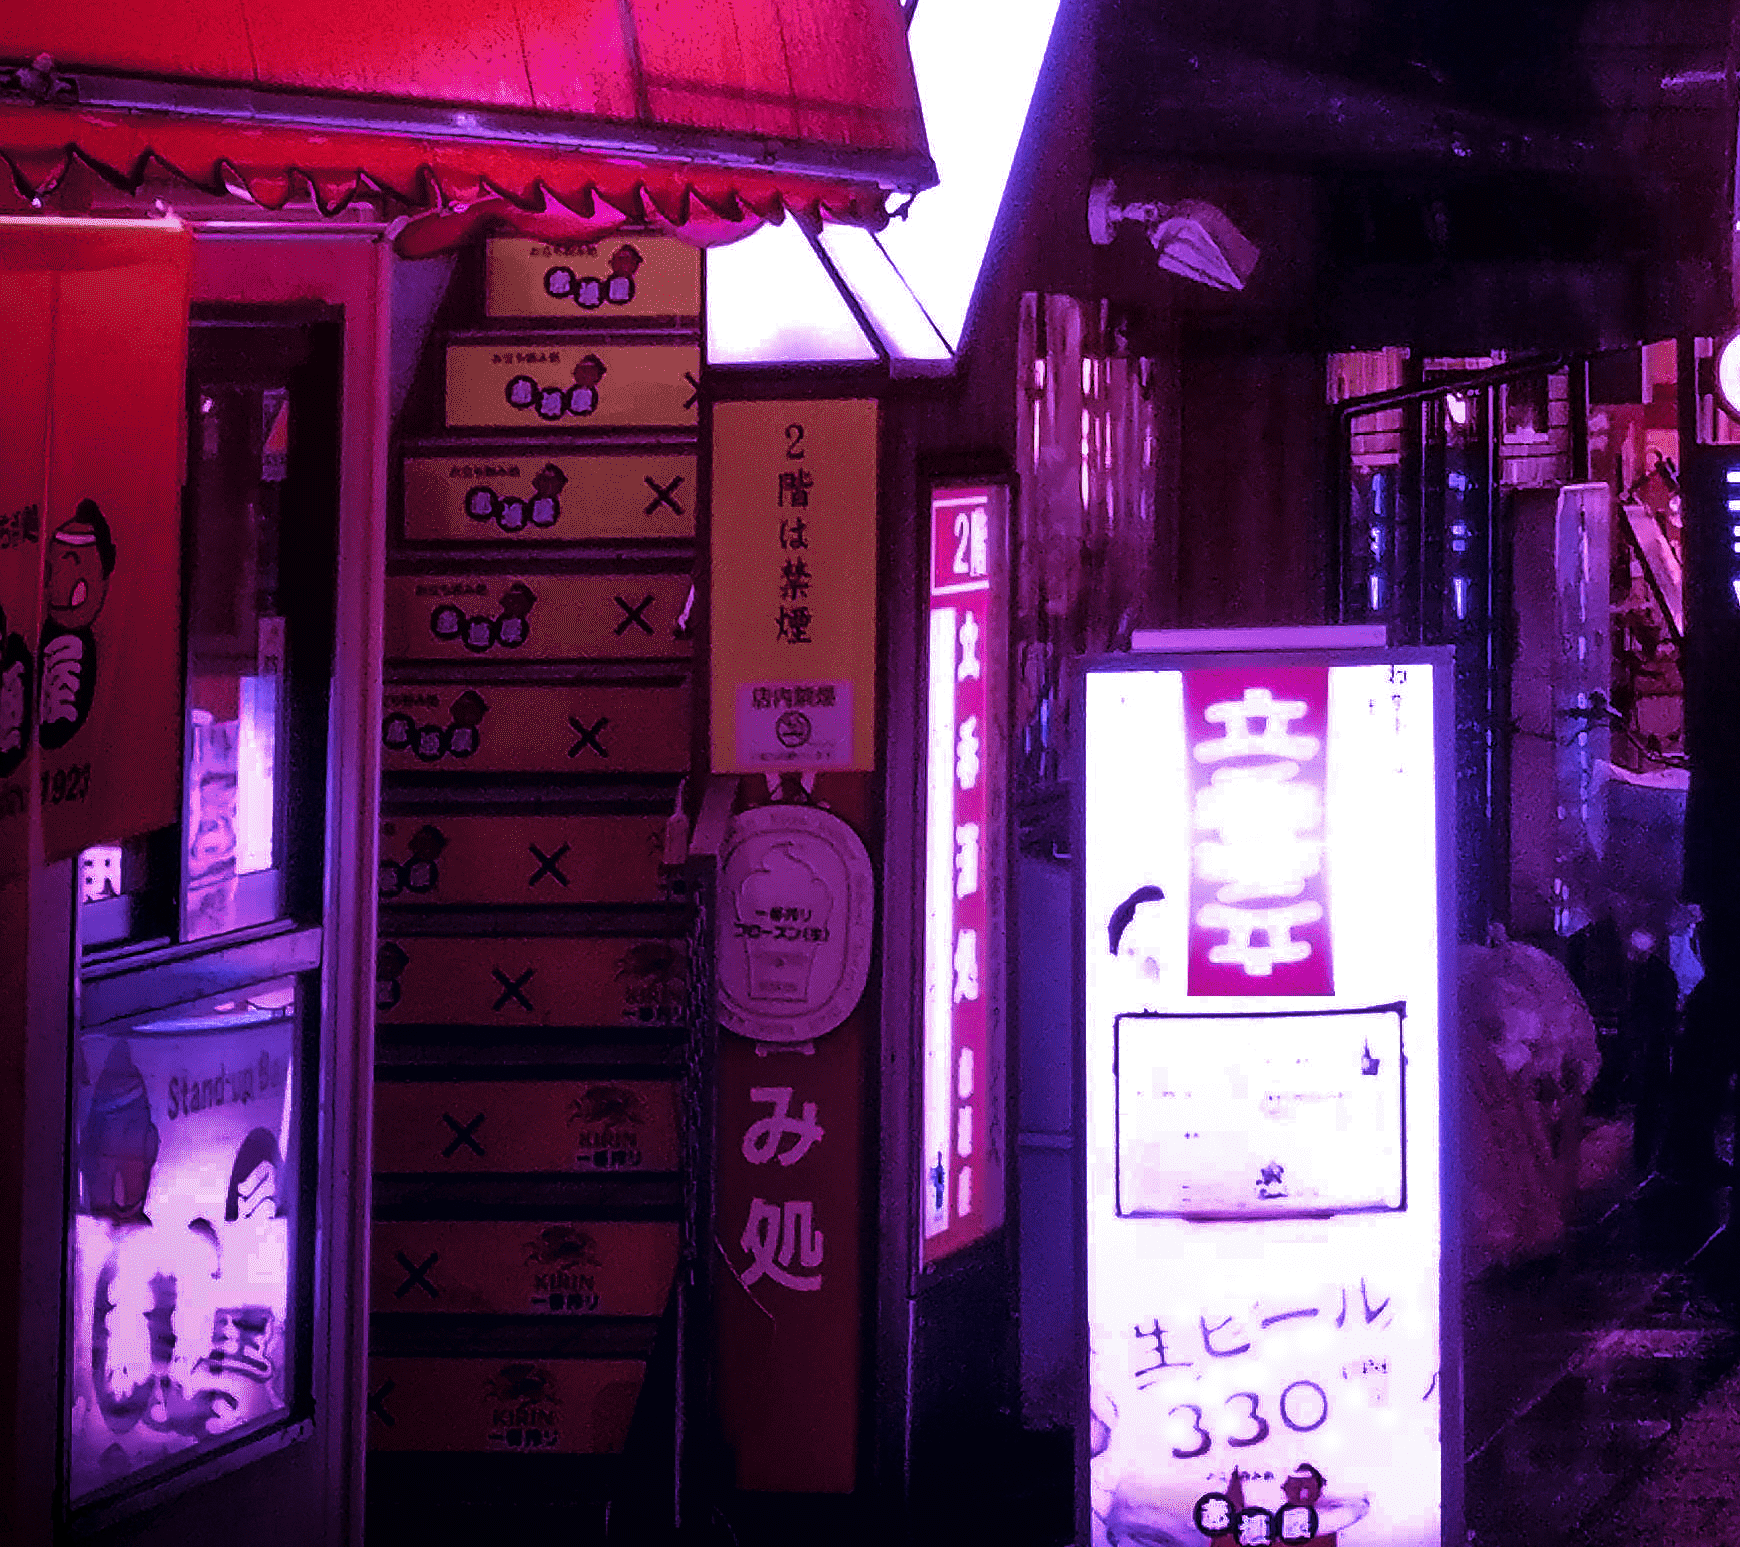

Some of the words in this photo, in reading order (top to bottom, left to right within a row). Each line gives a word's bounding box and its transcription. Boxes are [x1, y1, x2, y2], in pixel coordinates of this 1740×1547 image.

[775, 422, 814, 645] 2階は禁煙
[1168, 1379, 1328, 1459] 330
